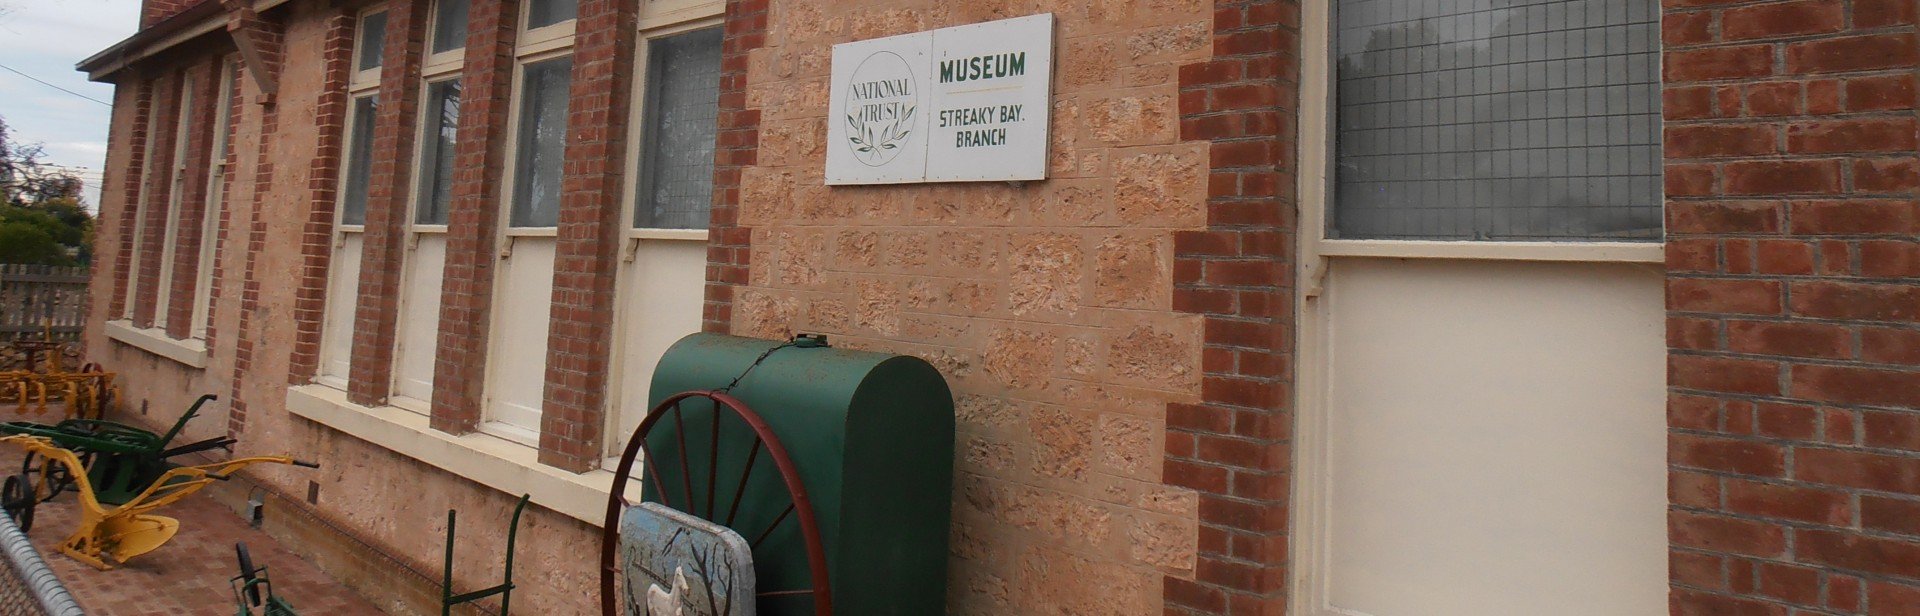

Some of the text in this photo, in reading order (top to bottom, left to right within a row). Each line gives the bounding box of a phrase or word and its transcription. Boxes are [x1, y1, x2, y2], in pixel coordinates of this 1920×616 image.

[940, 51, 1026, 83] MUSEUM
[853, 78, 911, 100] NATIONAL
[863, 102, 899, 122] TRUST
[940, 106, 996, 127] STREAKY
[956, 128, 1006, 148] BRANCH
